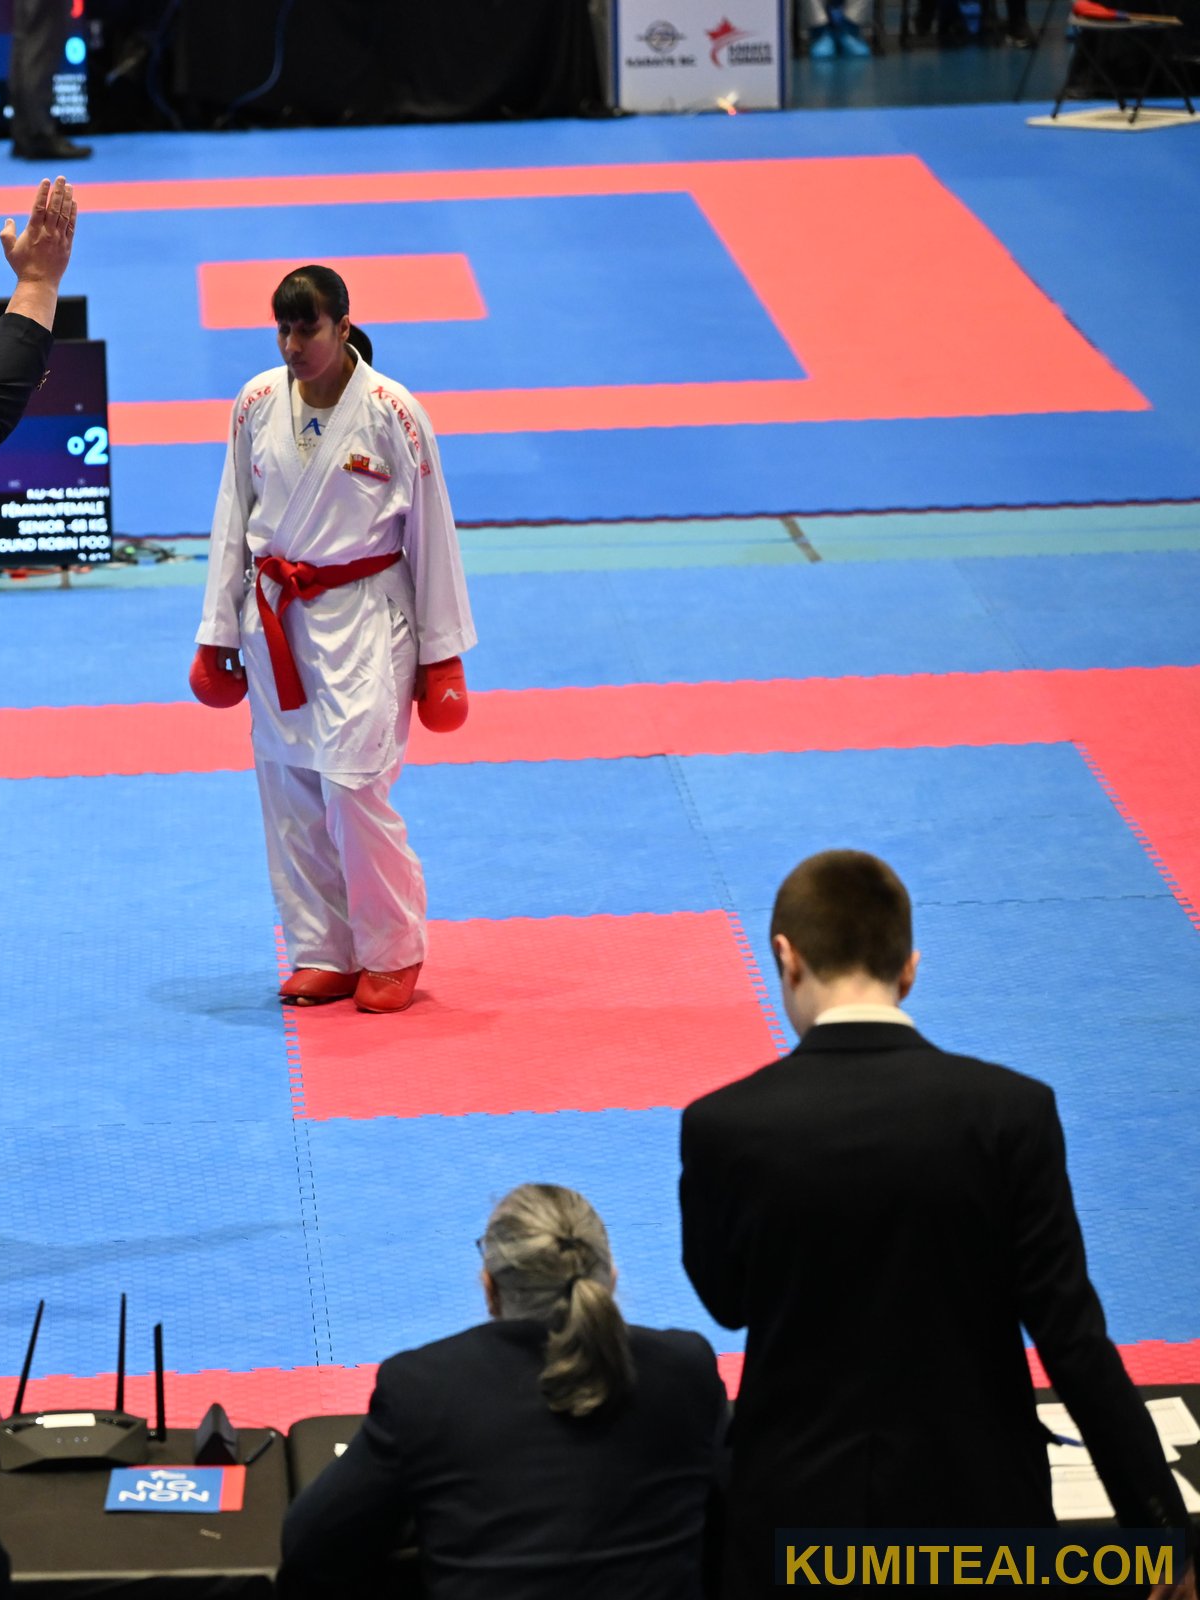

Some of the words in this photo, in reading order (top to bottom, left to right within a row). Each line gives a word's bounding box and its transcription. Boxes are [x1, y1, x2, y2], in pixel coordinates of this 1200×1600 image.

[37, 536, 79, 551] ROBIN
[79, 535, 111, 550] POO
[136, 1480, 197, 1492] NO
[118, 1489, 210, 1503] NON
